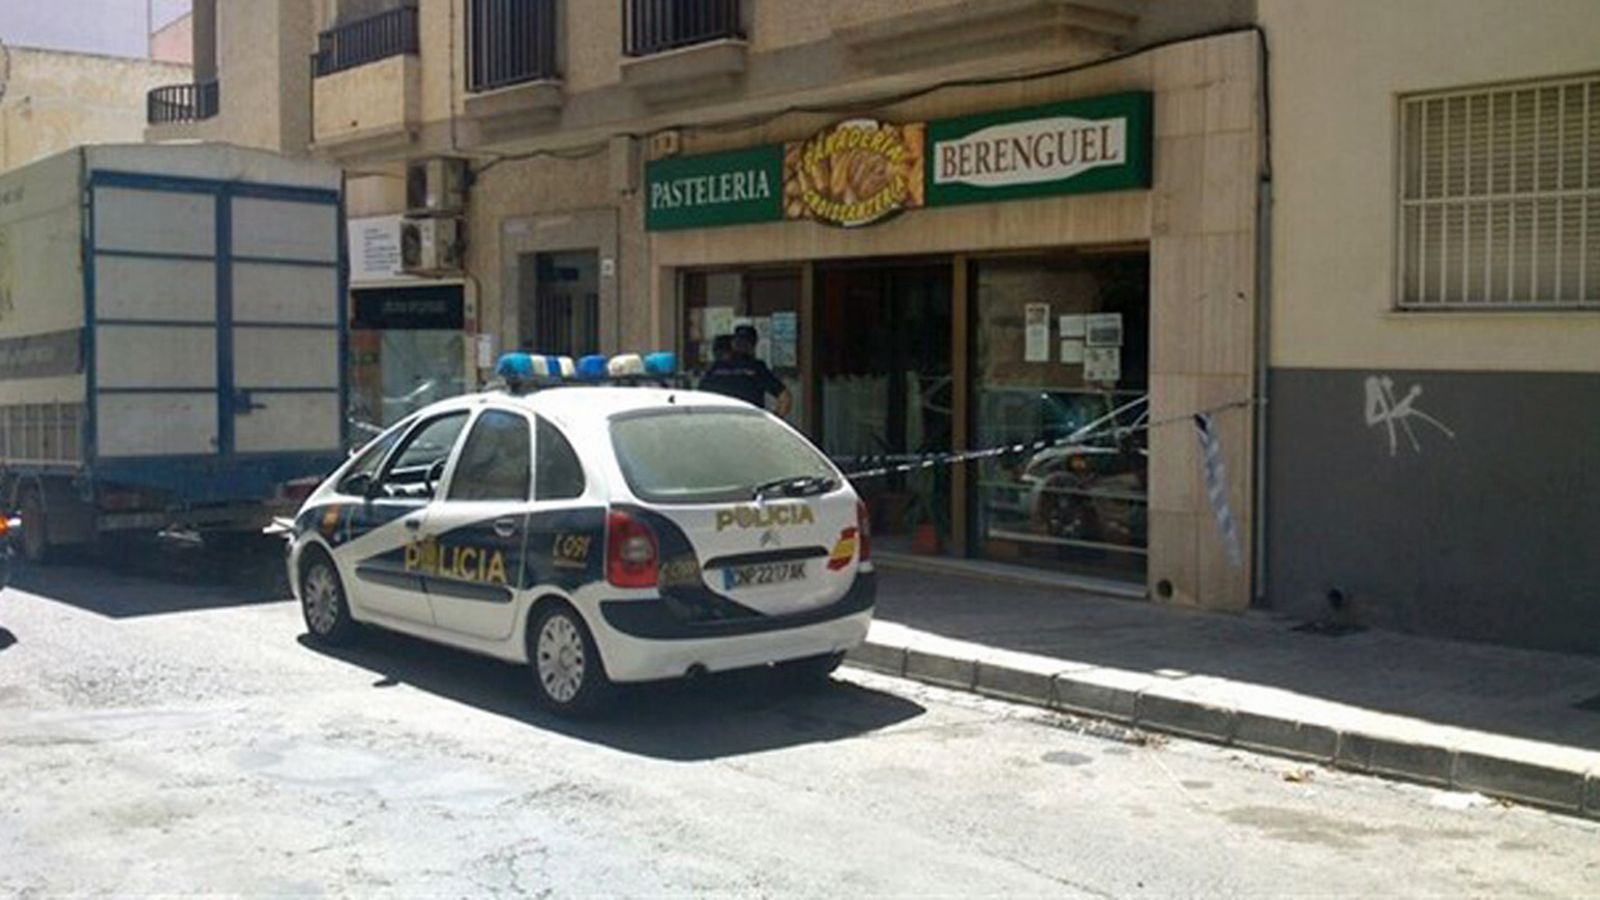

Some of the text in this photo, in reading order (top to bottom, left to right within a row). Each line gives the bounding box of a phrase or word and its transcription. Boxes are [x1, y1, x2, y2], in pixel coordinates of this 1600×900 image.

[940, 124, 1119, 178] BERENGUEL
[650, 169, 771, 211] PASTELERIA
[715, 504, 815, 532] POLICIA
[403, 538, 507, 584] POLICIA
